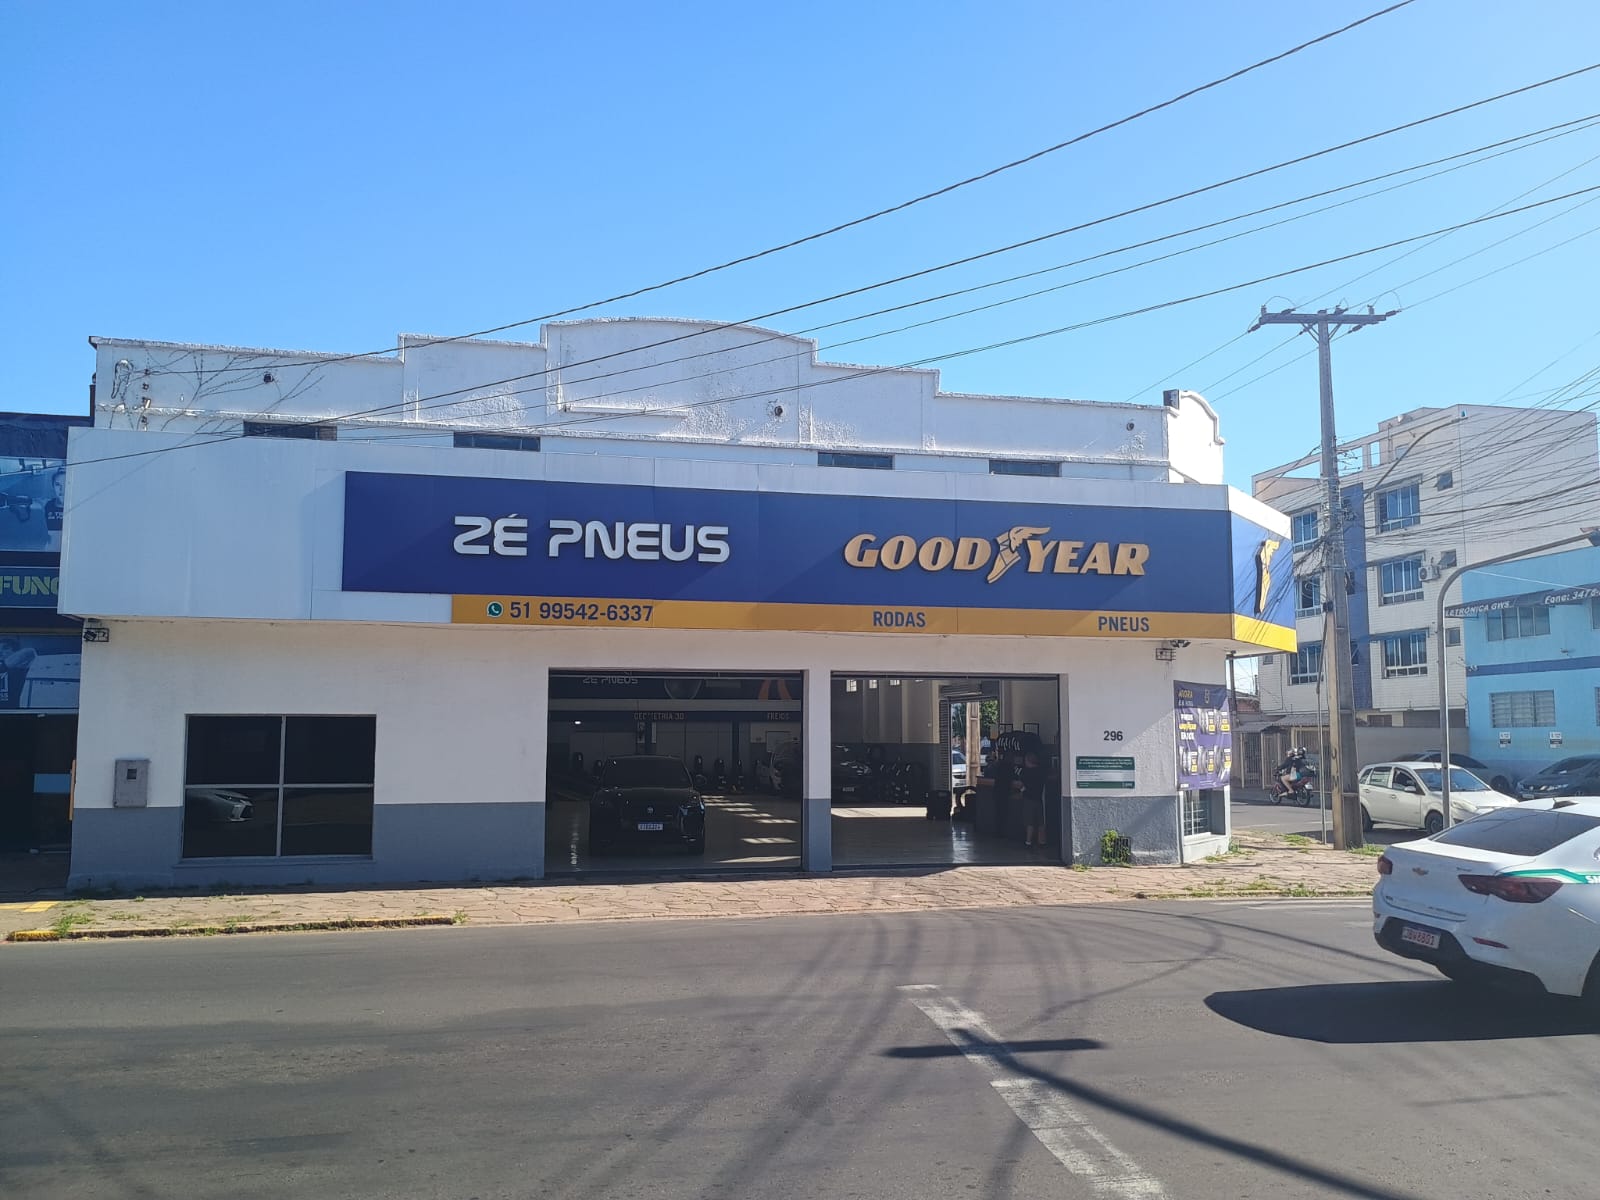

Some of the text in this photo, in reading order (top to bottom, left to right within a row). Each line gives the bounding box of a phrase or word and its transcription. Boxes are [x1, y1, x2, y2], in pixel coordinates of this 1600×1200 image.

[453, 513, 731, 563] ZÉ PNEUS
[510, 602, 653, 622] 51 99542-6337
[873, 611, 926, 628] RODAS
[1098, 616, 1150, 632] PNEUS
[1103, 730, 1123, 741] 296
